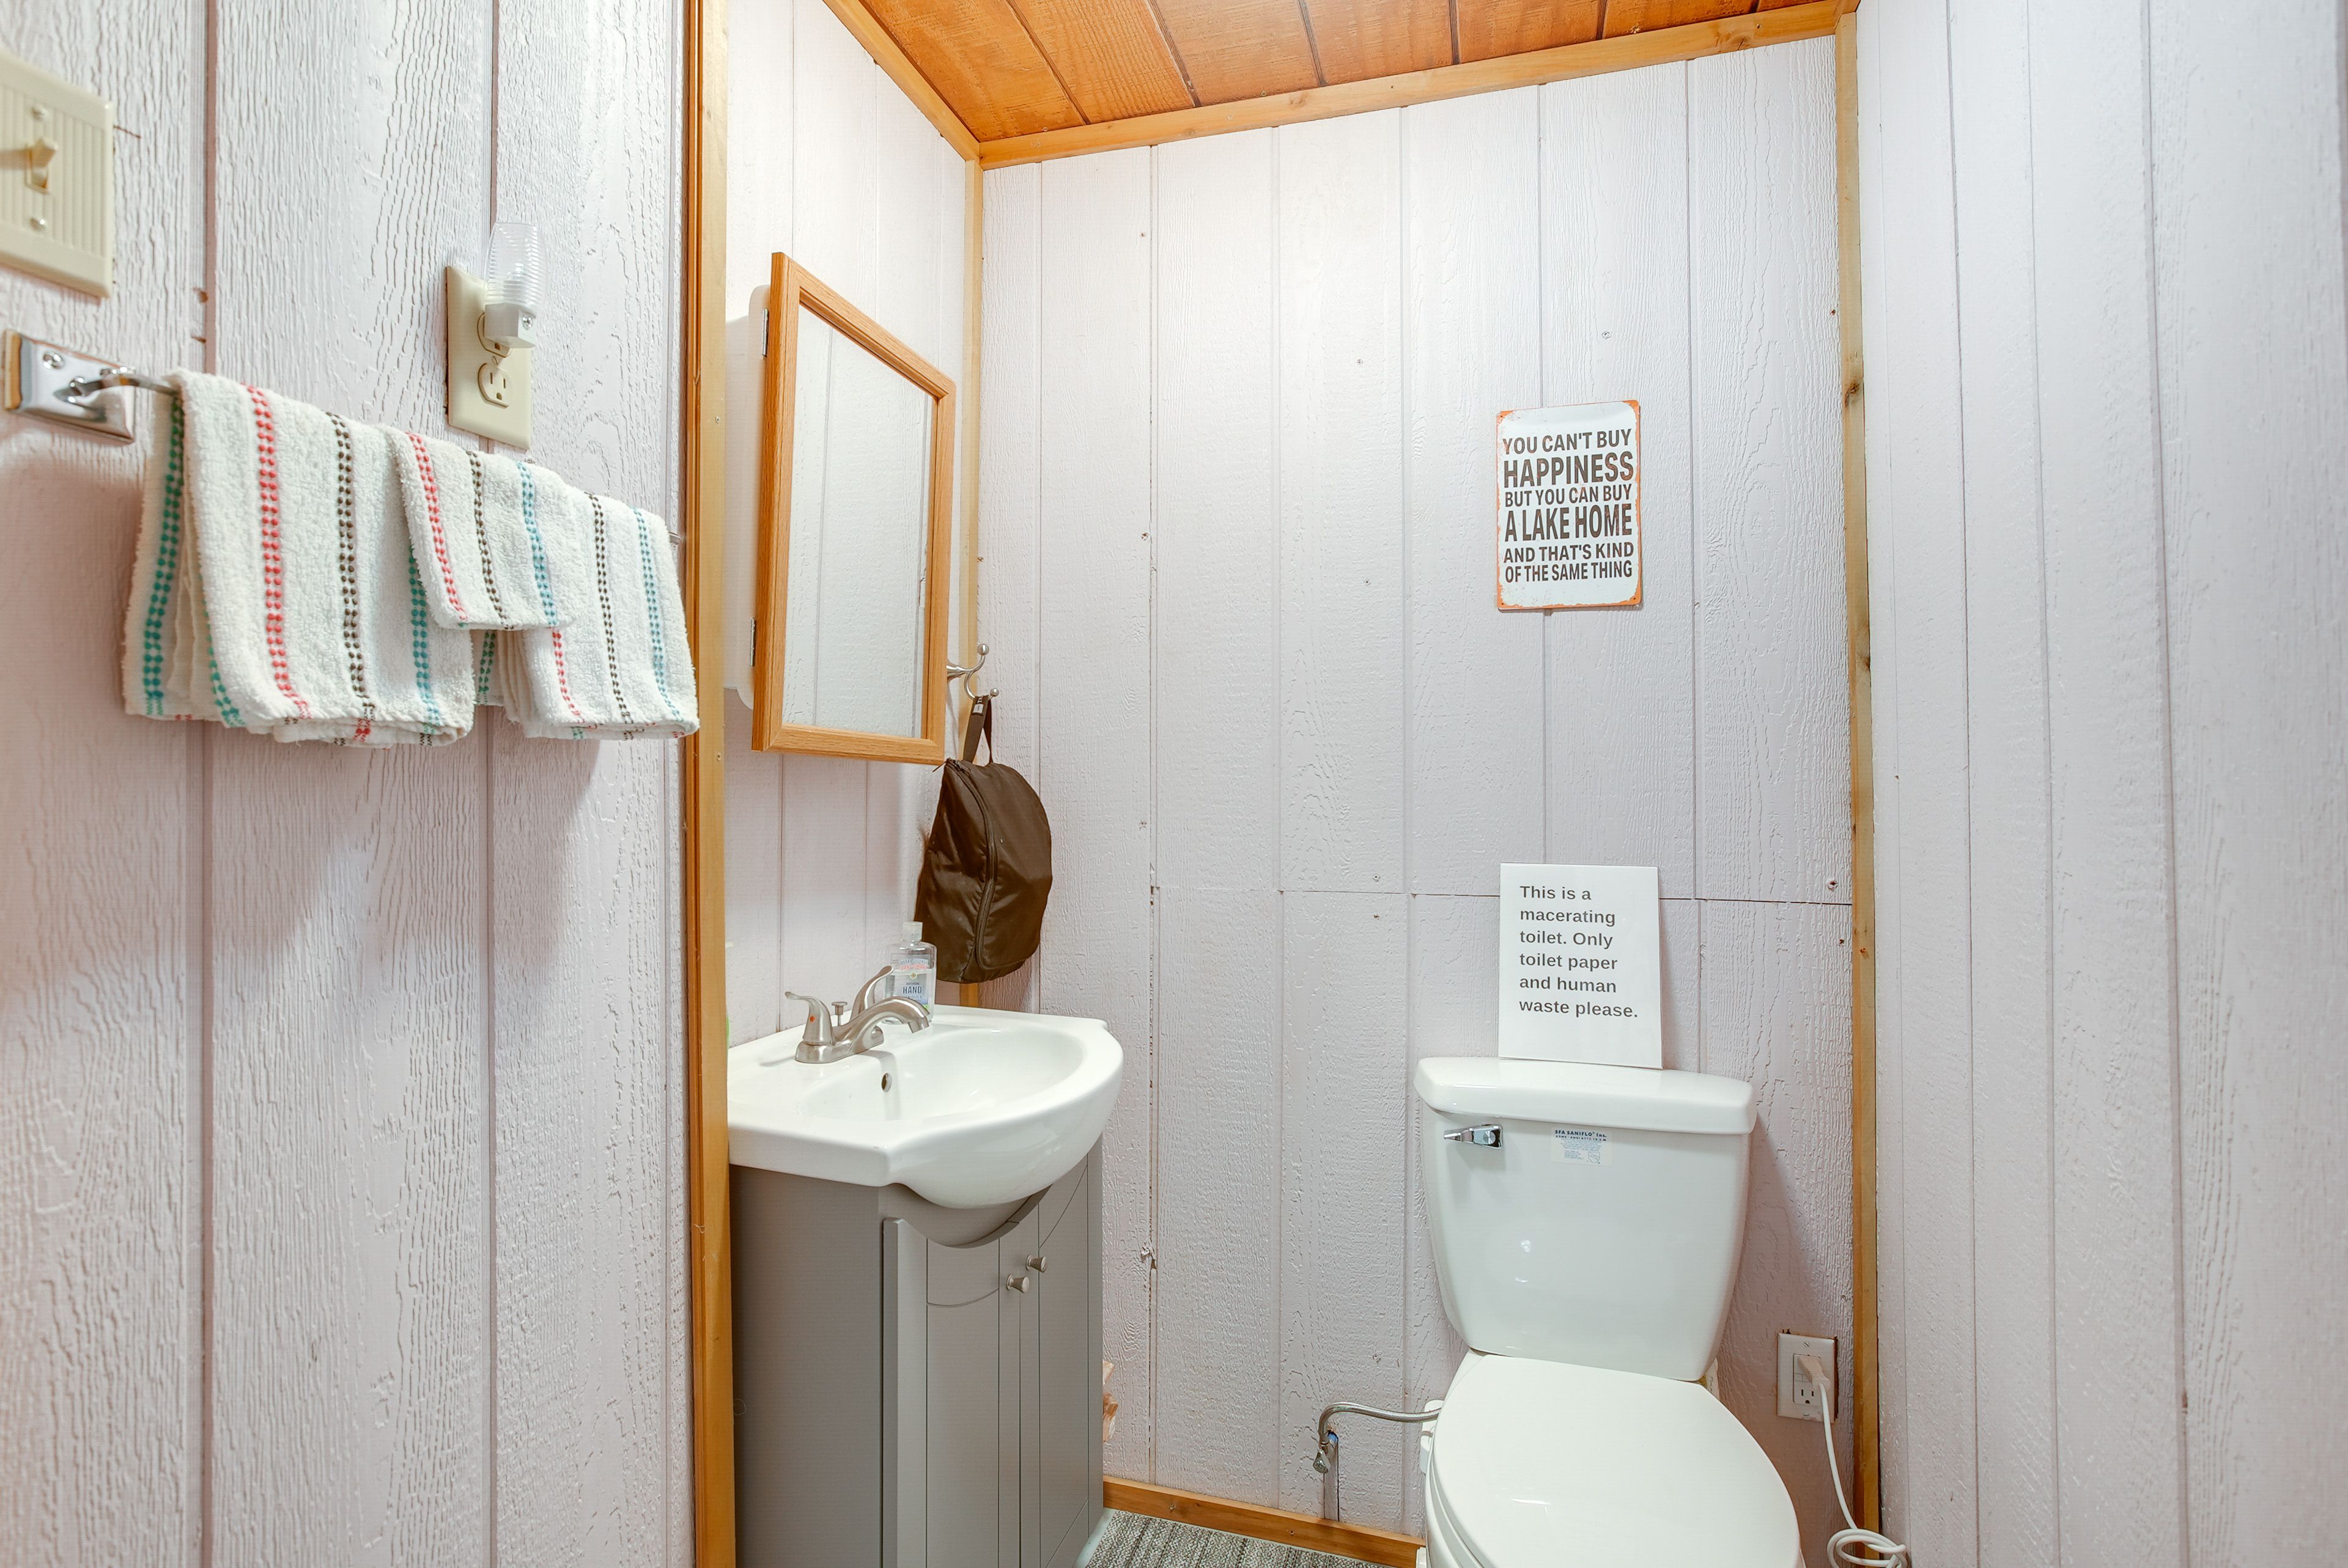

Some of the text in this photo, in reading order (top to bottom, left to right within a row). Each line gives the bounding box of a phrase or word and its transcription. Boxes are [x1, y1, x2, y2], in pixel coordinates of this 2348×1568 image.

[1502, 429, 1631, 454] YOU CAN'T BUY
[1504, 451, 1634, 488] HAPPINESS
[1505, 484, 1632, 507] BUT YOU CAN BUY
[1505, 504, 1632, 542] A LAKE HOME
[1504, 542, 1634, 563] AND THAT'S KIND
[1505, 560, 1633, 583] OF THE SAME THING
[1520, 886, 1591, 900] This is a
[1521, 910, 1615, 927] macerating
[1520, 931, 1613, 949] toilet. Only
[1519, 954, 1618, 971] toilet paper
[1519, 977, 1616, 993] and human
[1519, 1001, 1637, 1017] waste please.
